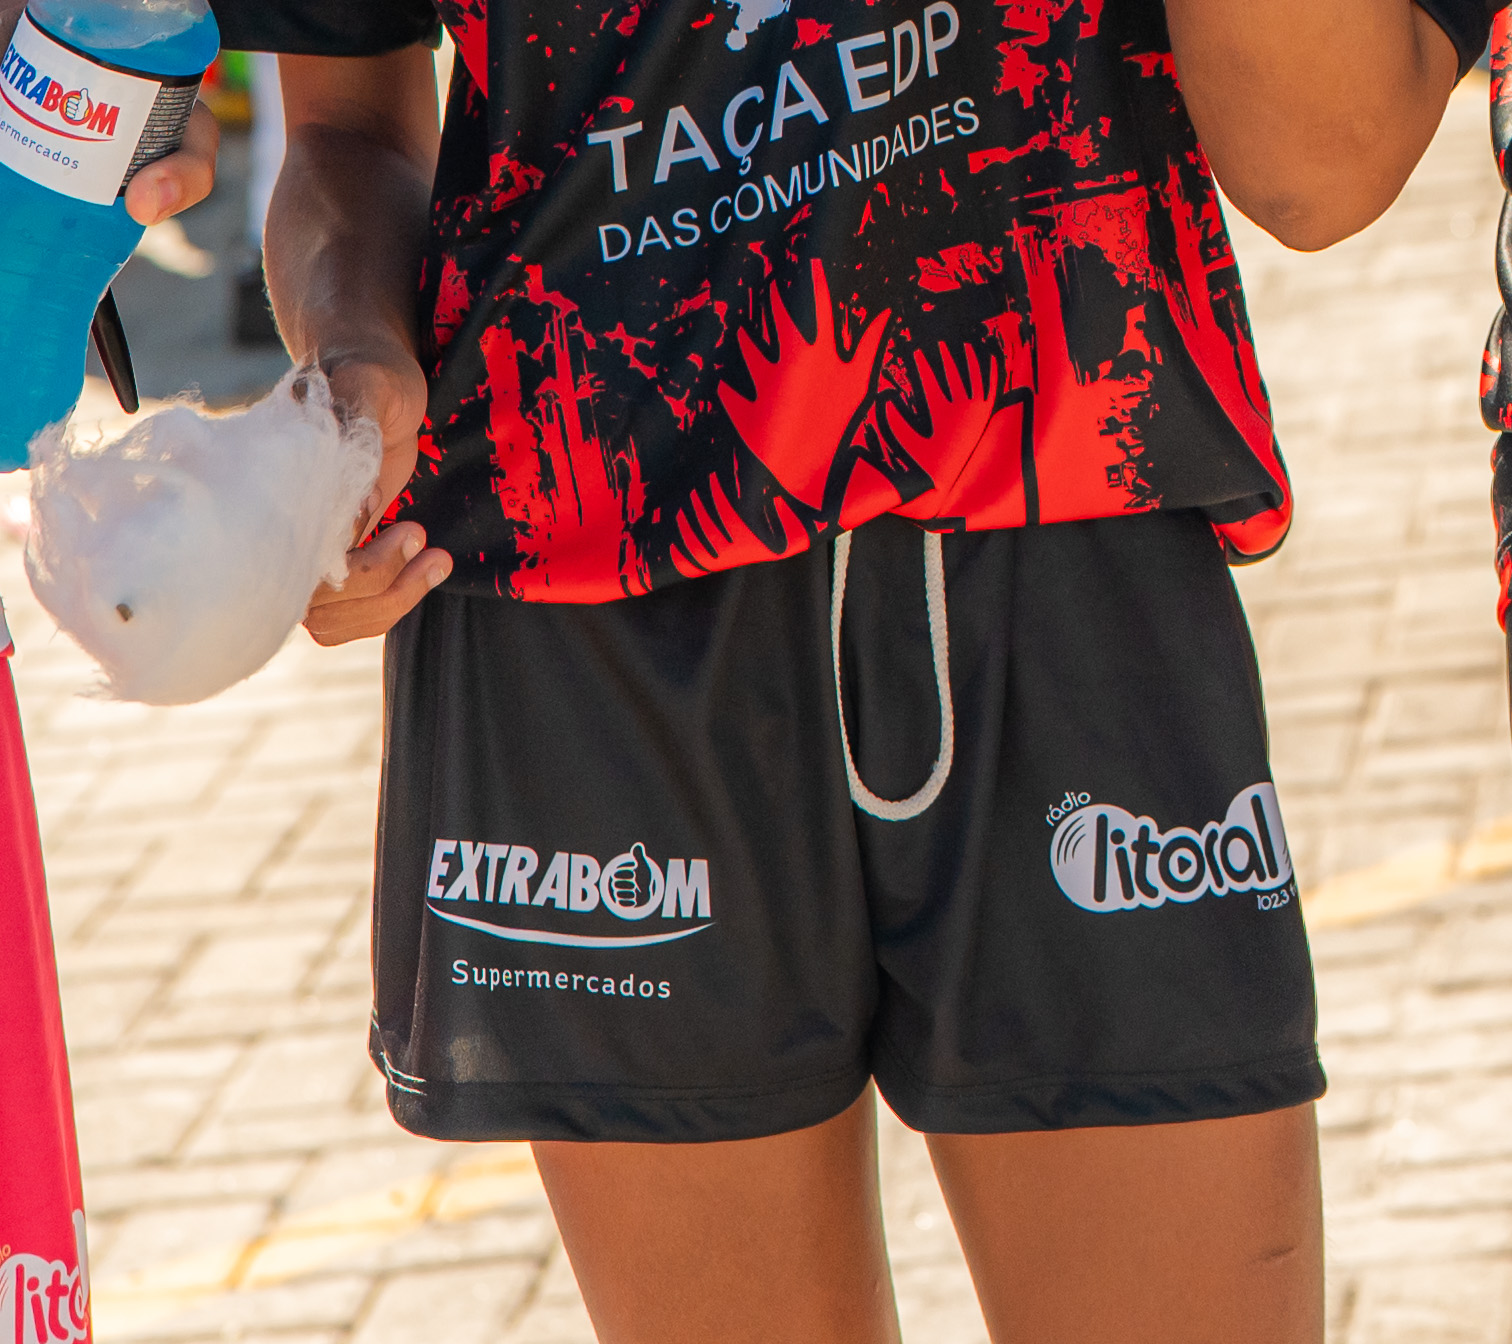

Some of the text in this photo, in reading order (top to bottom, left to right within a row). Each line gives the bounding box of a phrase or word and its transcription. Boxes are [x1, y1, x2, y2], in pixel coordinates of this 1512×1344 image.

[586, 0, 961, 177] TAÇA EDP
[597, 96, 981, 264] DAS COMUNIDADES
[1045, 791, 1092, 826] rádio
[1092, 793, 1280, 904] litoral
[427, 838, 713, 922] EXTRABOM
[451, 959, 672, 999] Supermercados
